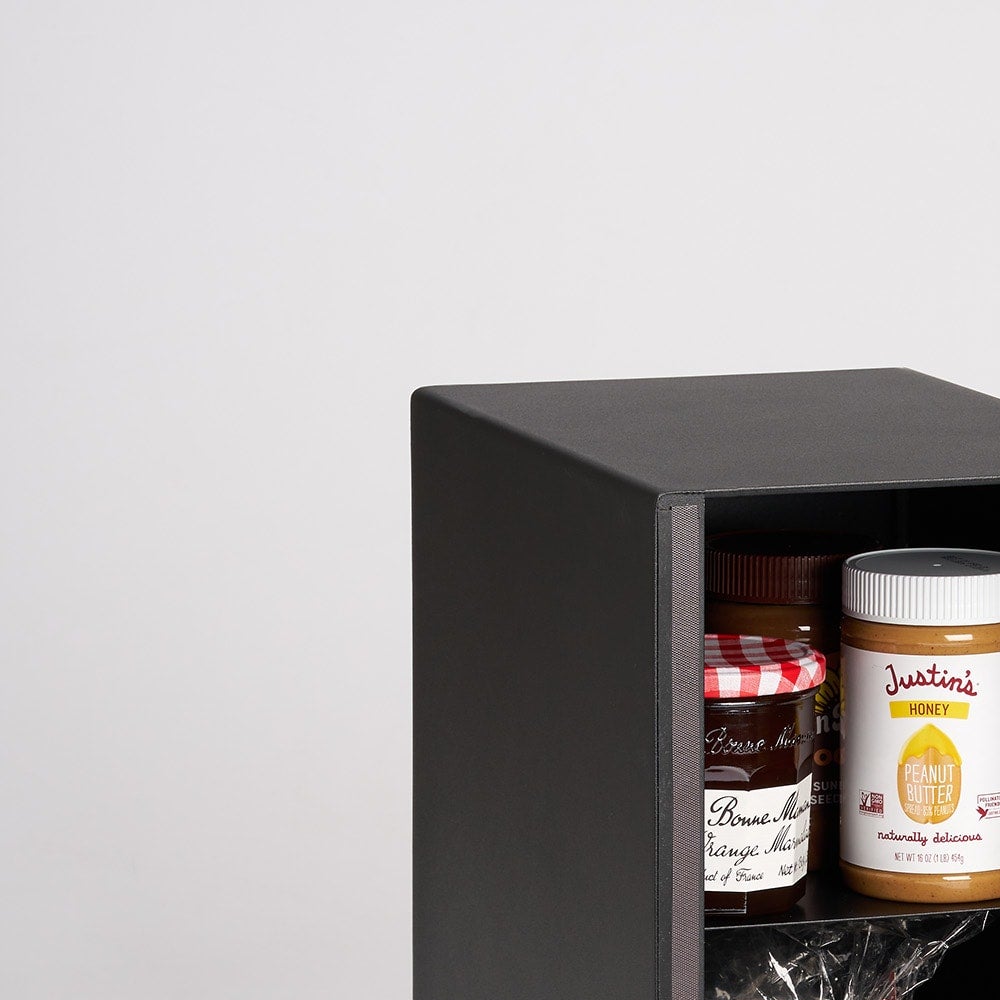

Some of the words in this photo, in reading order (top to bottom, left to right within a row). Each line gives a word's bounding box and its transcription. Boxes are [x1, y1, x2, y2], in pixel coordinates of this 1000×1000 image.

[885, 663, 978, 696] Justin's
[909, 703, 950, 716] HONEY
[905, 763, 955, 784] PEANUT
[907, 783, 953, 805] BUTTER
[708, 795, 771, 827] Bonne
[878, 830, 928, 846] naturally
[933, 832, 982, 844] delicious
[895, 853, 904, 862] NET
[906, 853, 915, 862] WT
[917, 853, 924, 863] 16
[925, 853, 932, 863] OZ
[720, 868, 732, 886] of
[735, 867, 766, 882] France
